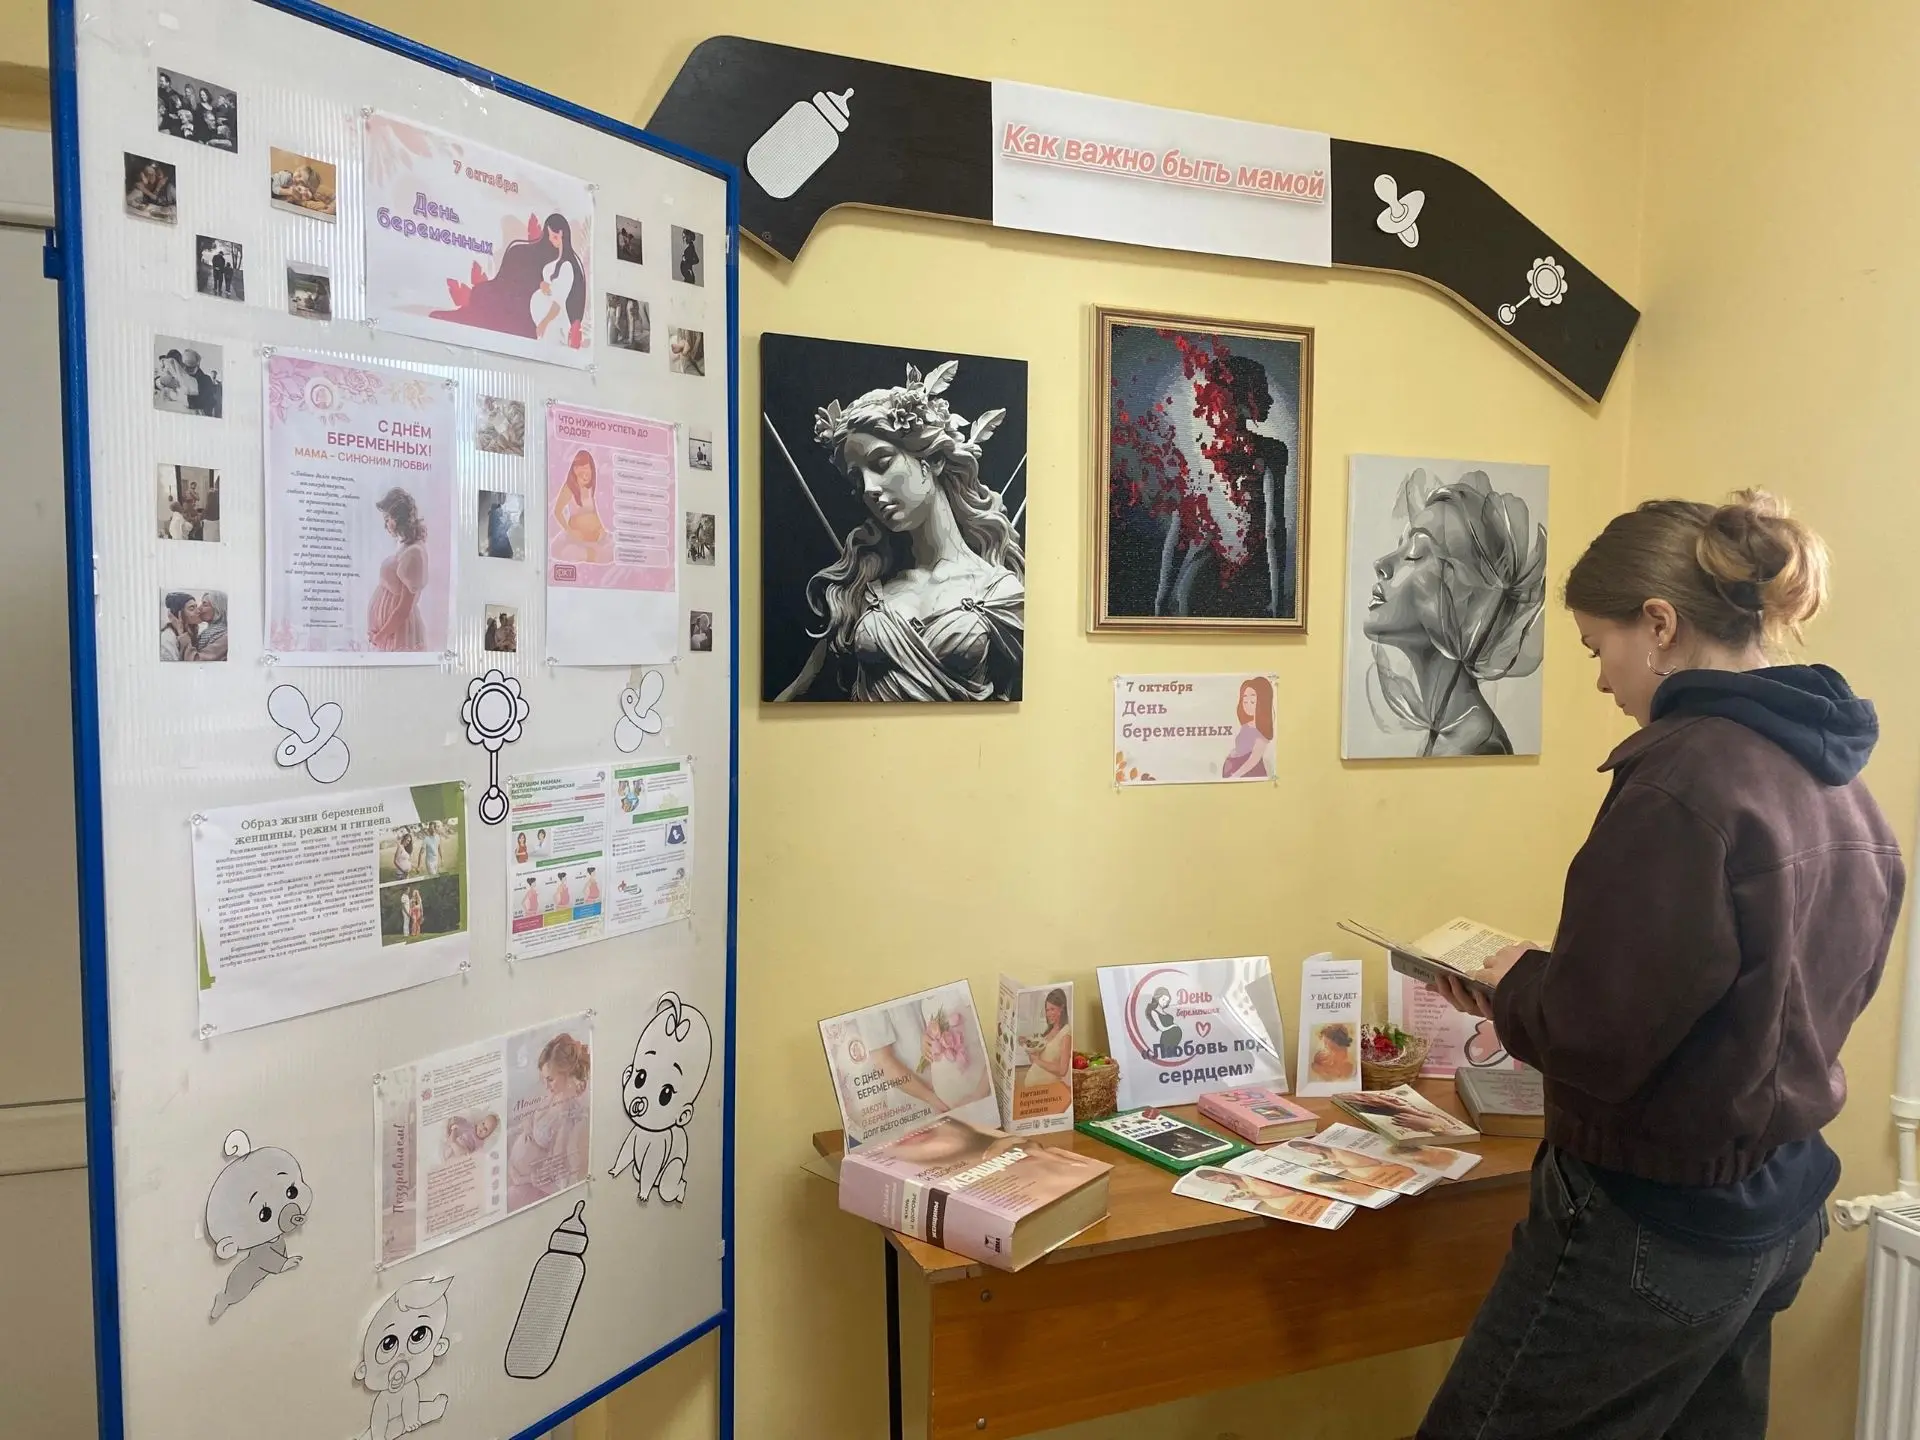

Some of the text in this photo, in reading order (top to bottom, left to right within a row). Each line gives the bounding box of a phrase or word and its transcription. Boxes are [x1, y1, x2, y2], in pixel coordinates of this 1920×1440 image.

[1003, 122, 1324, 198] Как важно быть мамой
[453, 159, 519, 194] 7 октября
[412, 192, 460, 224] День
[376, 206, 494, 256] беременных
[378, 420, 431, 439] С ДНЁМ
[559, 415, 648, 438] ЧТО НУЖНО УСПЕТЬ ДО
[559, 425, 591, 438] РОДОВ?
[327, 431, 431, 457] БЕРЕМЕННЫХ!
[294, 447, 328, 459] МАМА
[337, 452, 391, 466] СИНОНИМ
[393, 458, 432, 471] ЛЮБВИ!
[1126, 681, 1193, 694] 7 октября
[1122, 700, 1167, 717] День
[1122, 723, 1233, 741] беременных
[241, 803, 384, 831] Образ жизни беременной
[234, 830, 296, 845] женщины,
[300, 823, 337, 838] режим
[340, 822, 347, 830] и
[350, 816, 391, 831] гигиена
[1177, 988, 1212, 1005] День
[1317, 993, 1332, 1001] ВАС
[1333, 993, 1357, 1001] БУДЕТ
[853, 1068, 884, 1086] С ДНЁМ
[857, 1074, 912, 1099] БЕРЕМЕННЫХ!
[1159, 1063, 1253, 1085] сердцем»
[863, 1108, 932, 1140] ДОЛГ ВСЕГО ОБЩЕСТВА
[393, 1124, 408, 1214] Поздравляем!
[939, 1147, 1028, 1191] ЖЕНЩИНЫ
[931, 1201, 939, 1238] ЖЕНЩИНЫ
